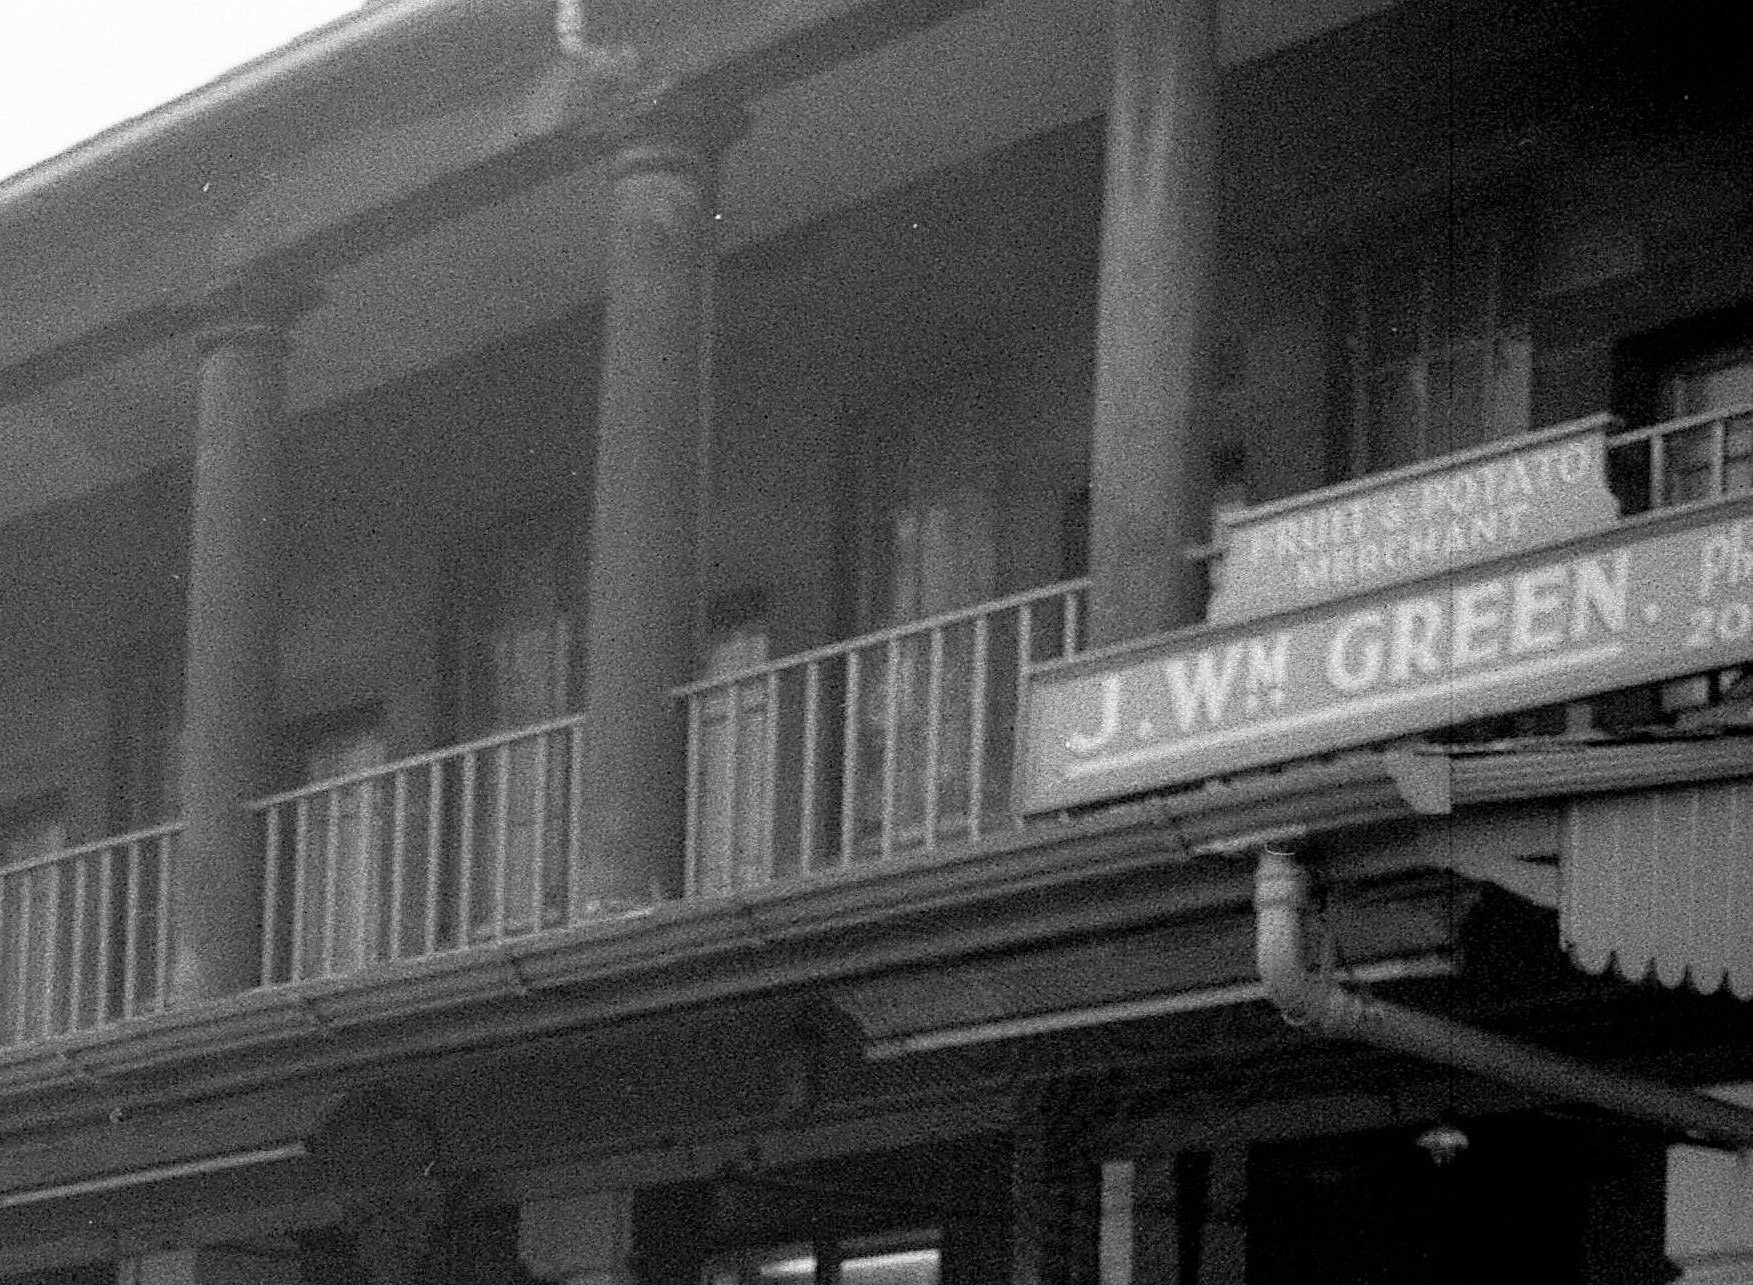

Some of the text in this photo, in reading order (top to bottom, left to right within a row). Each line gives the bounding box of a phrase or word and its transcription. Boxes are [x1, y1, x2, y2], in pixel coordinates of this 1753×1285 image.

[1249, 499, 1367, 565] FRUIT
[1420, 442, 1593, 517] POTATO
[1296, 502, 1532, 592] MERCHANT
